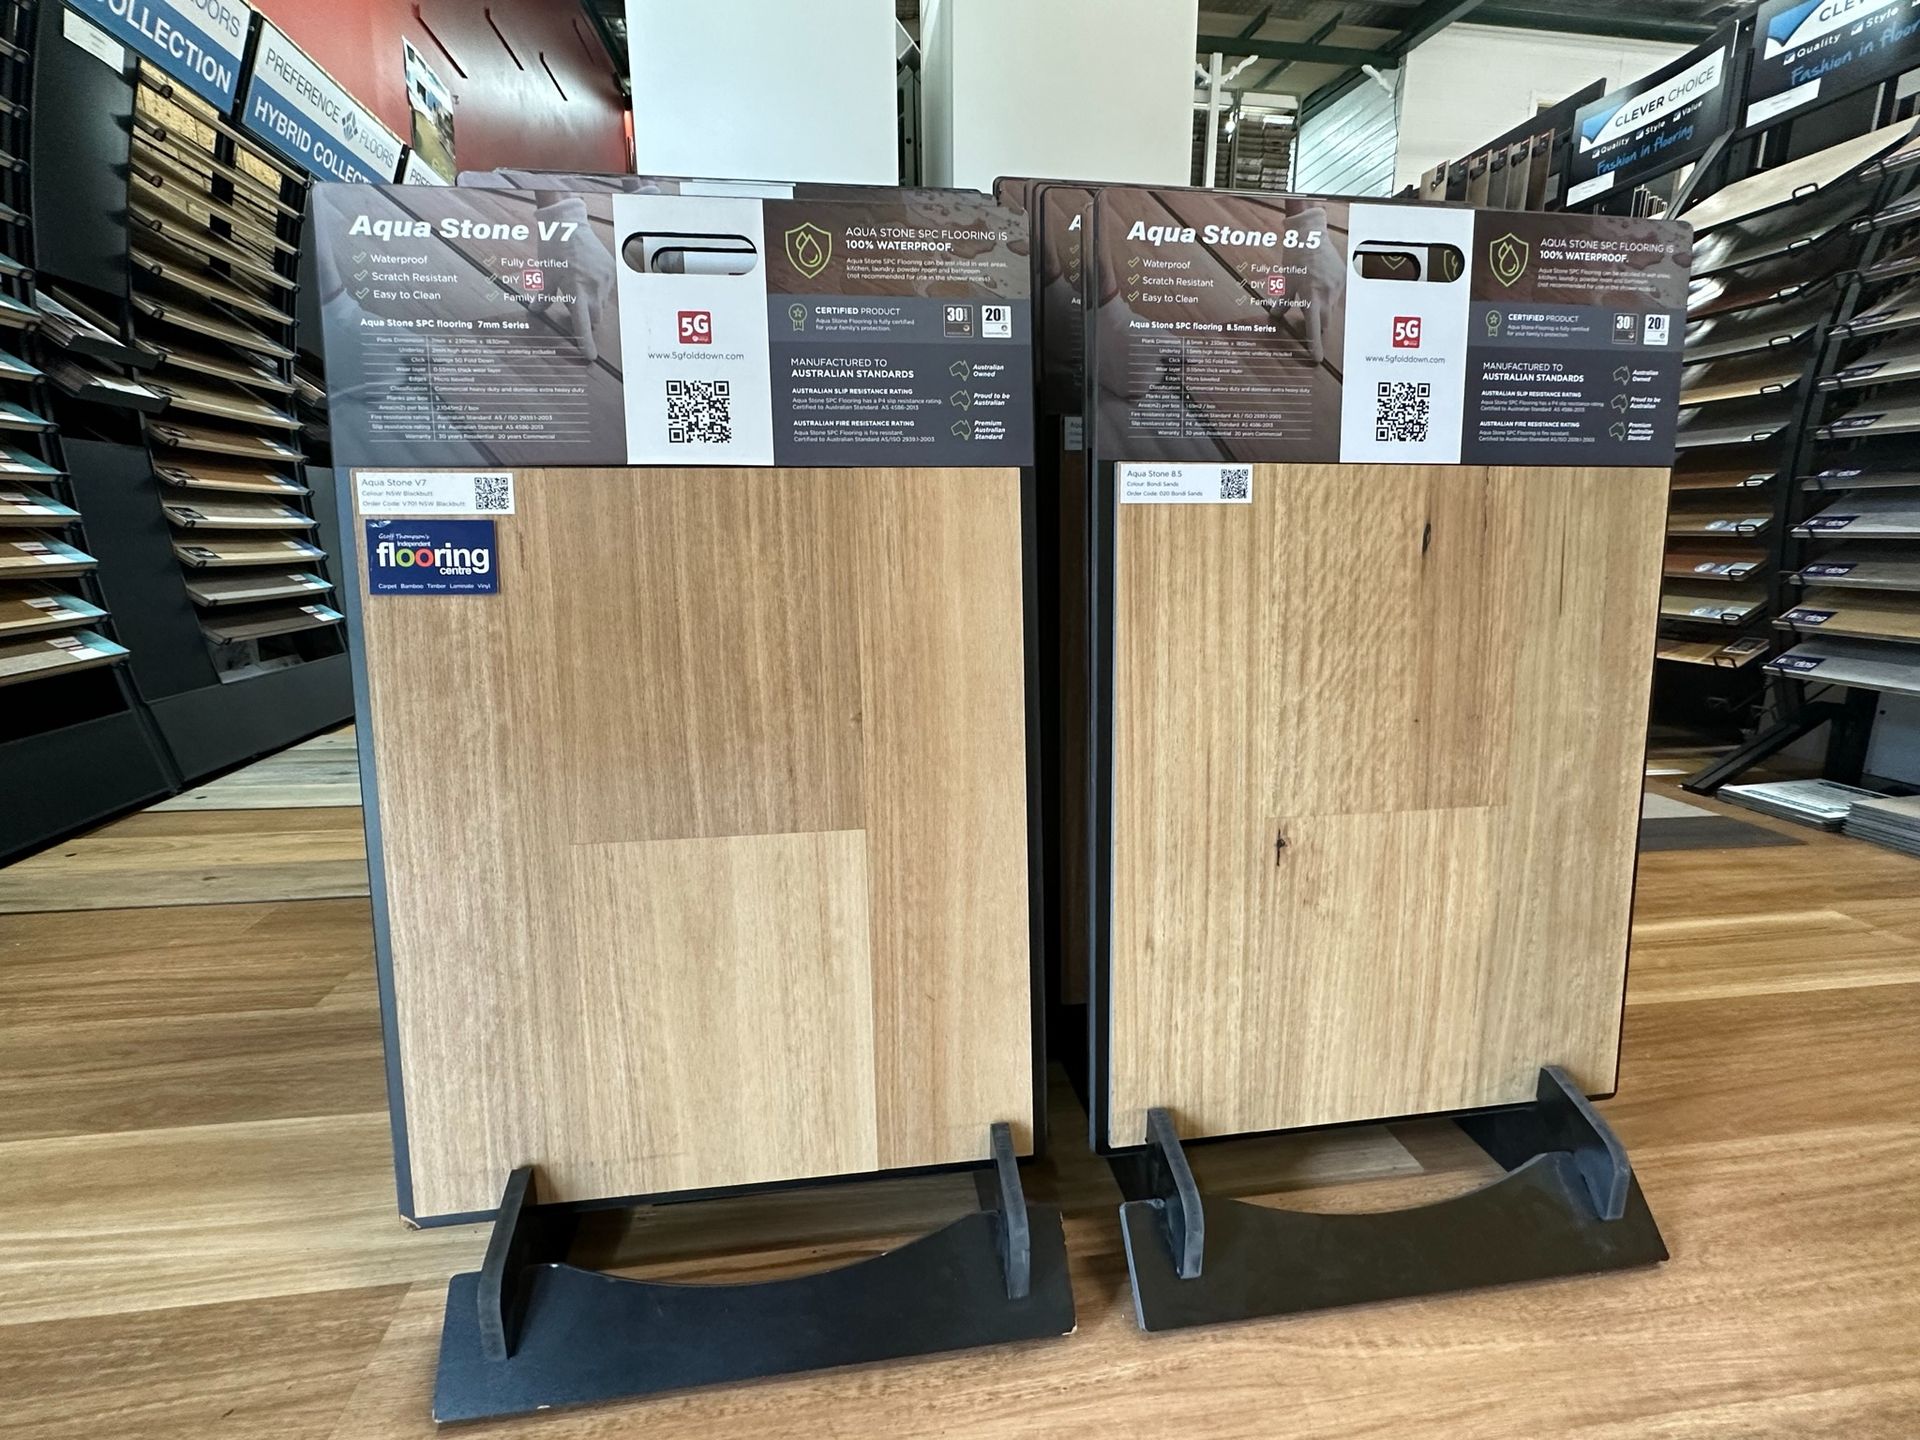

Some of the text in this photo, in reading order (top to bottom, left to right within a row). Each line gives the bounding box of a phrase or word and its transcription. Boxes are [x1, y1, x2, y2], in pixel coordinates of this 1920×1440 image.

[1797, 7, 1899, 57] Quality Style
[98, 0, 232, 94] OLLECTION
[1791, 18, 1920, 85] Fashion in floor
[1615, 66, 1714, 127] CLEVER CHOICE
[265, 48, 395, 168] PREFERENCE FLOORS
[254, 96, 312, 152] HYBRID
[1601, 101, 1702, 154] Quality Style Value
[1597, 125, 1694, 174] Fashion in flooring
[349, 215, 578, 242] Aqua Stone V7
[846, 227, 1008, 241] AQUA STONE SPC FLOORING IS
[1127, 221, 1321, 248] Aqua Stone 8.5
[846, 240, 954, 252] 100% WATERPROOF.
[1541, 238, 1674, 253] AQUA STONE SPC FLOORING IS
[370, 254, 427, 265] Waterproof
[501, 258, 568, 268] Fully Certified
[1540, 251, 1629, 263] 100% WATERPROOF.
[1143, 259, 1191, 269] Waterproof
[1251, 264, 1307, 274] Fully Certified
[372, 272, 458, 283] Scratch Resistant
[502, 273, 541, 285] DIY 5G
[1143, 276, 1214, 287] Scratch Resistant
[1270, 279, 1283, 290] 5G
[374, 290, 441, 301] Easy to Clean
[503, 293, 576, 304] Family Friendly
[1142, 293, 1199, 303] Easy to Clean
[1250, 298, 1311, 308] Family Friendly
[947, 307, 963, 322] 30
[985, 308, 1001, 321] 20
[361, 318, 529, 330] Aqua Stone SPC flooring 7mm Series
[681, 314, 708, 337] 5G
[1129, 320, 1276, 333] Aqua Stone SPC flooring 8.5mm Series
[1616, 316, 1630, 329] 30
[1648, 317, 1661, 329] 20
[1395, 320, 1419, 340] 5G
[648, 351, 744, 360] www.5gfolddown.com
[1365, 355, 1445, 364] www.5gfolddown.com
[791, 358, 887, 367] MANUFACTURED TO
[1483, 362, 1550, 371] MANUFACTURED
[791, 369, 914, 378] AUSTRALIAN STANDARDS
[1483, 373, 1584, 382] AUSTRALIAN STANDARDS
[1127, 470, 1146, 478] Aqua
[376, 542, 489, 574] flooring
[440, 567, 472, 575] centre
